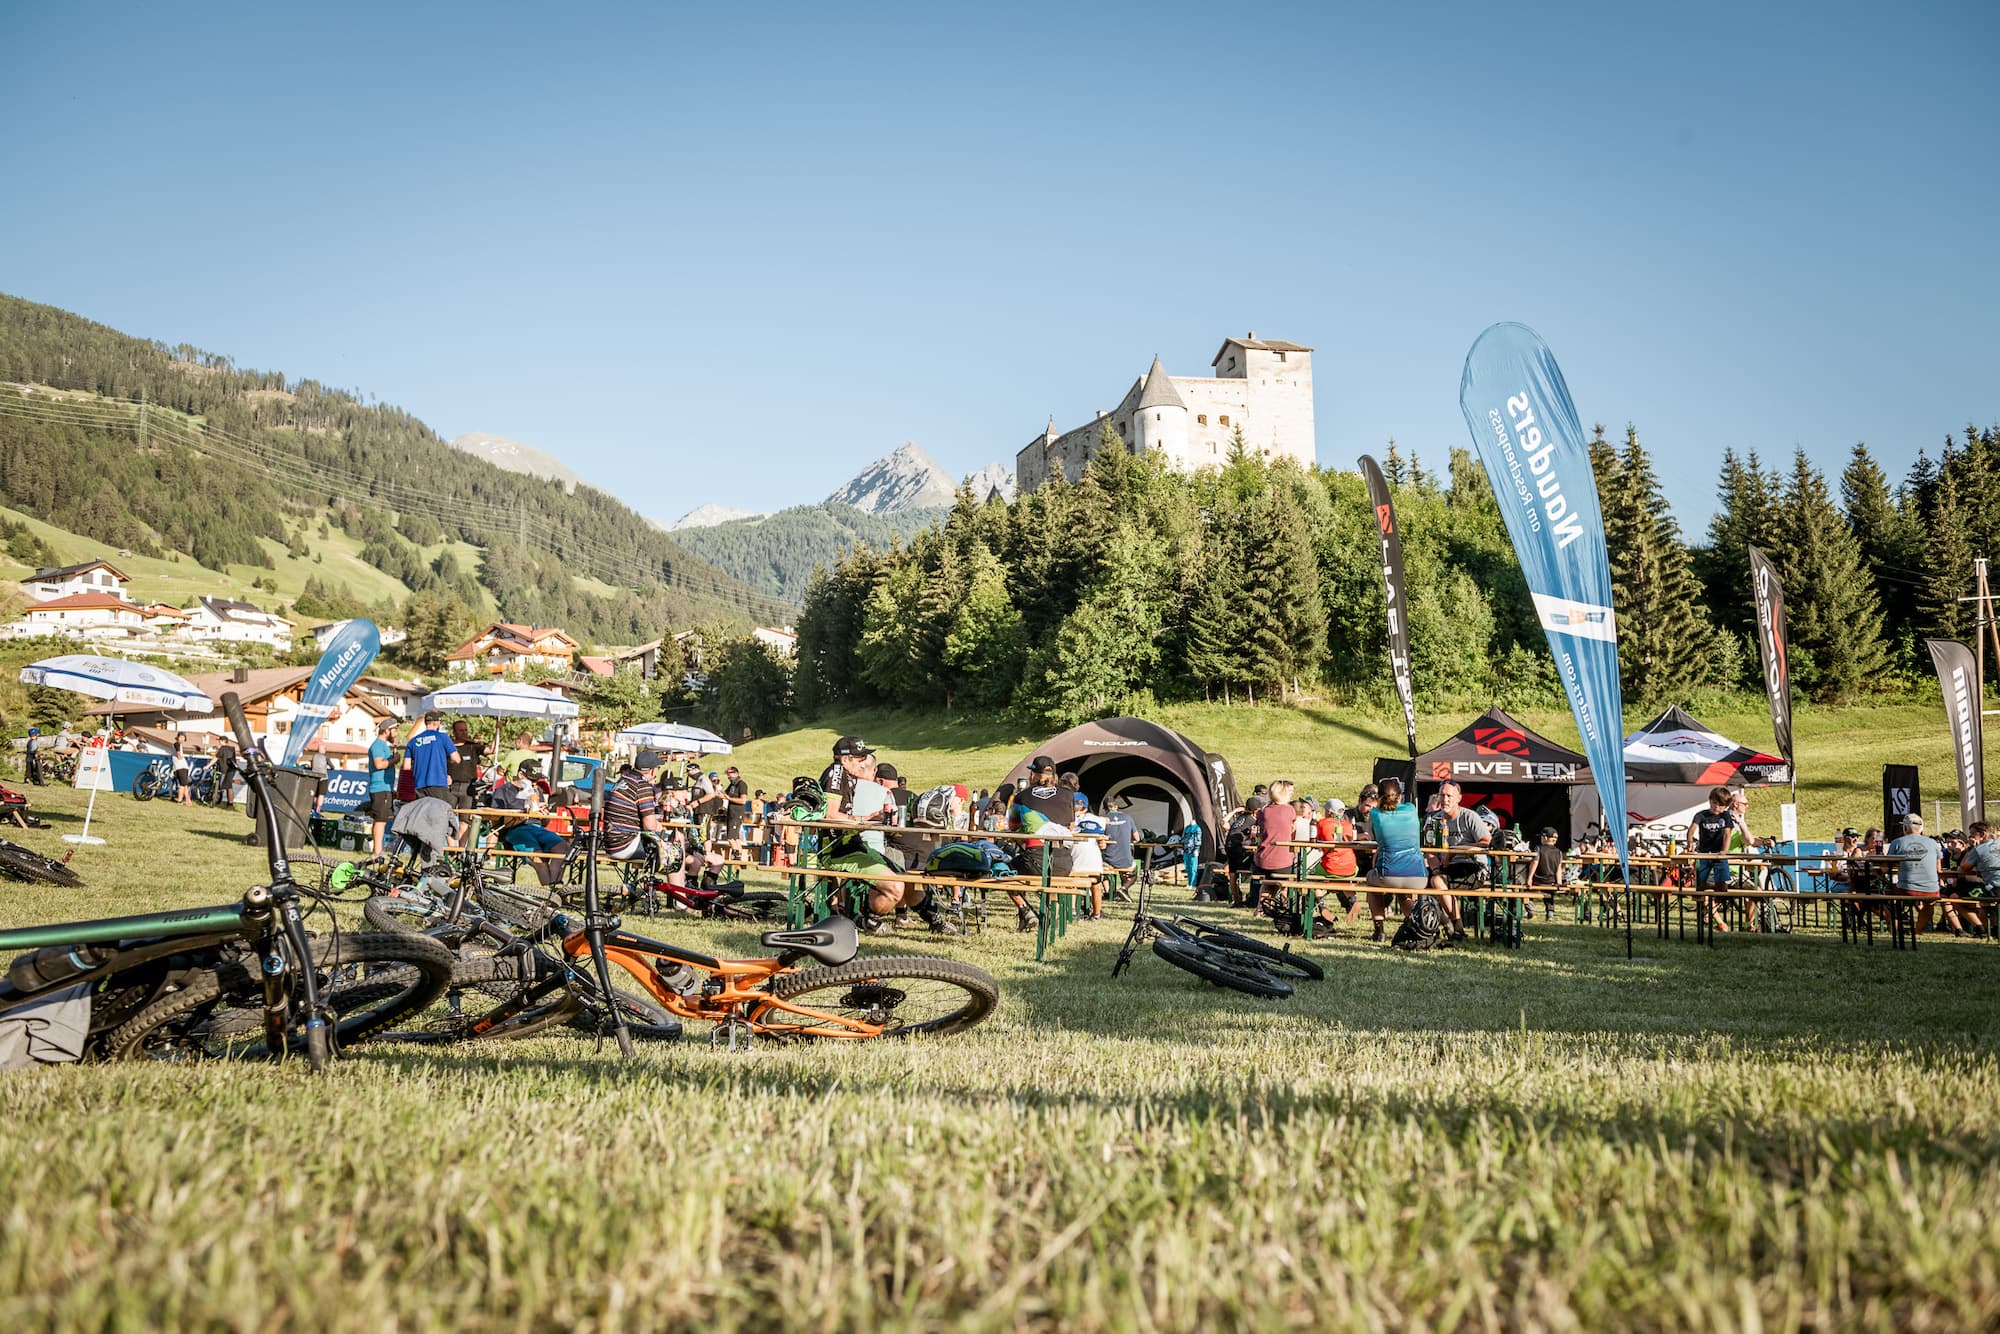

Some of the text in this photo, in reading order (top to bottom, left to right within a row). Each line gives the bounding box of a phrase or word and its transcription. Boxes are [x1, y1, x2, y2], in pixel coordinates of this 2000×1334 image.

[318, 640, 362, 690] Nauders
[1648, 740, 1730, 749] NORCO
[1453, 762, 1576, 776] FIVE TEN
[327, 774, 368, 796] ders
